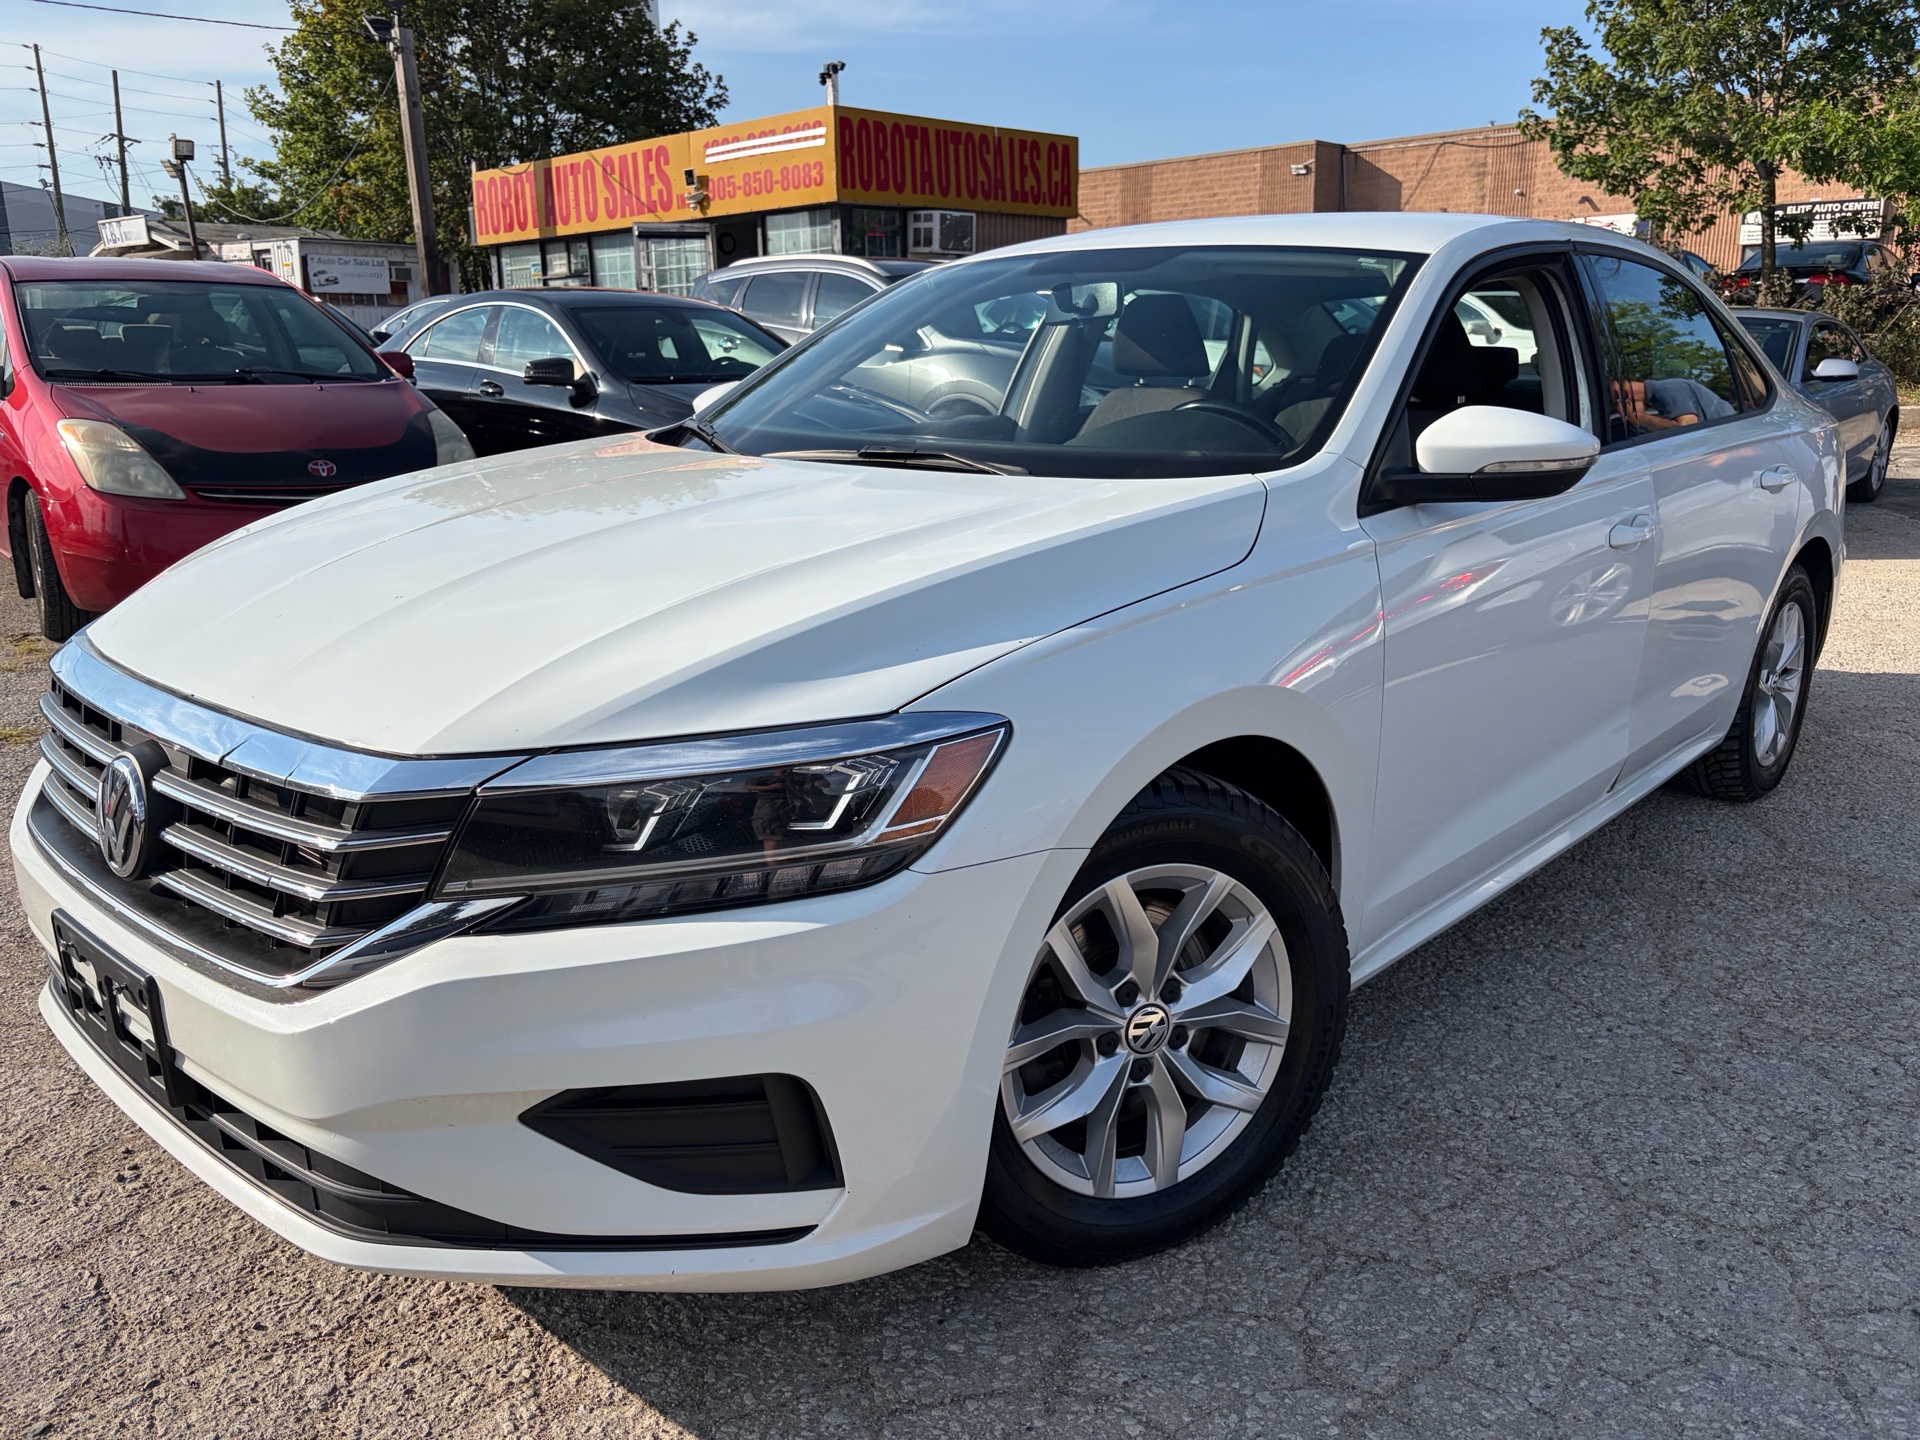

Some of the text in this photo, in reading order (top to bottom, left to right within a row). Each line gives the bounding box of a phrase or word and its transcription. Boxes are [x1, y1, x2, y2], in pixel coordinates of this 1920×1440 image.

[838, 115, 1073, 207] ROBOTAUTOSALES.CA
[475, 171, 539, 236] ROBOT
[543, 158, 599, 228] AUTO
[602, 144, 674, 219] SALES
[708, 160, 825, 202] 905-850-8083
[1813, 202, 1842, 213] AUTO
[1842, 200, 1881, 211] CENTRE
[316, 257, 336, 265] Auto
[337, 257, 352, 266] Car
[353, 258, 370, 267] Sale
[1097, 820, 1199, 854] STUDDABLE
